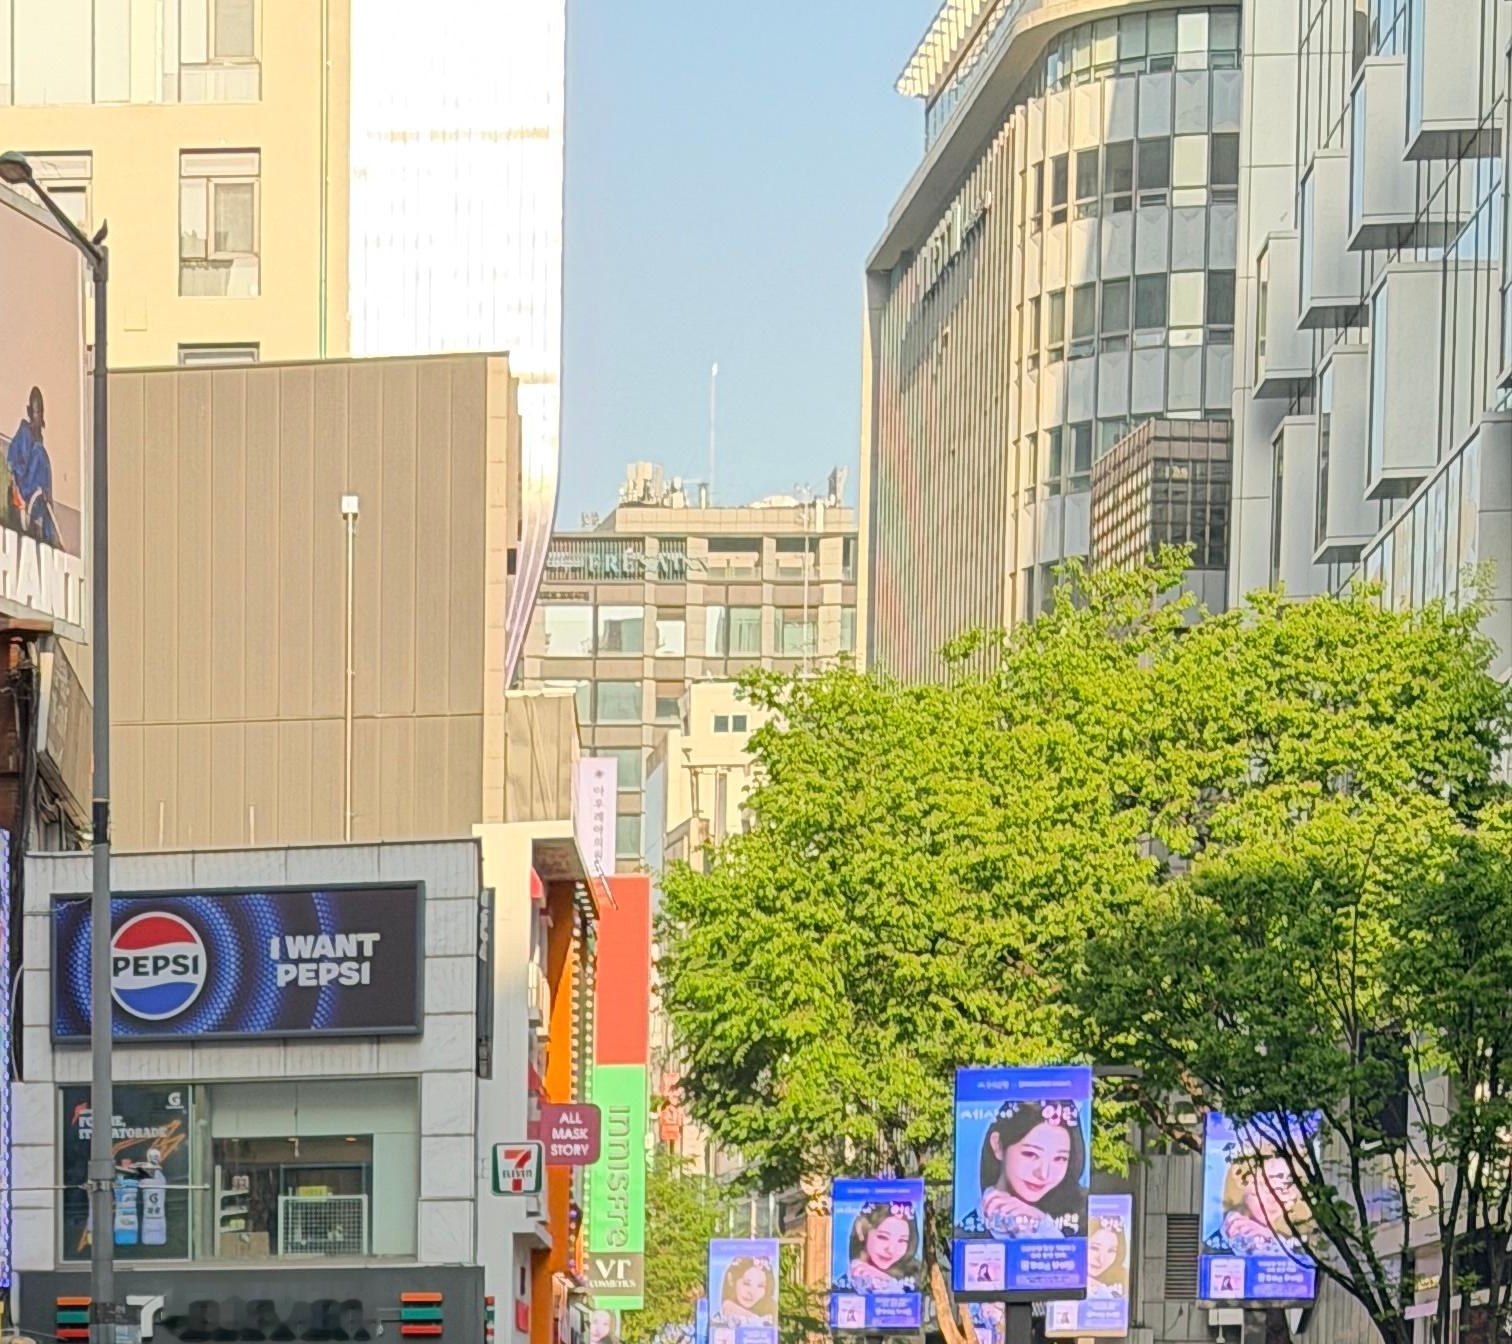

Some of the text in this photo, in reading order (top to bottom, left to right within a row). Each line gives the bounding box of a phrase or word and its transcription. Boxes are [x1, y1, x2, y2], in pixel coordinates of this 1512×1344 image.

[270, 932, 380, 960] I WANT
[113, 954, 199, 977] PEPSI
[276, 961, 371, 987] PEPSI
[559, 1111, 583, 1124] ALL
[112, 1128, 168, 1139] ATORADE
[552, 1128, 589, 1140] MASK
[551, 1144, 589, 1156] STORY
